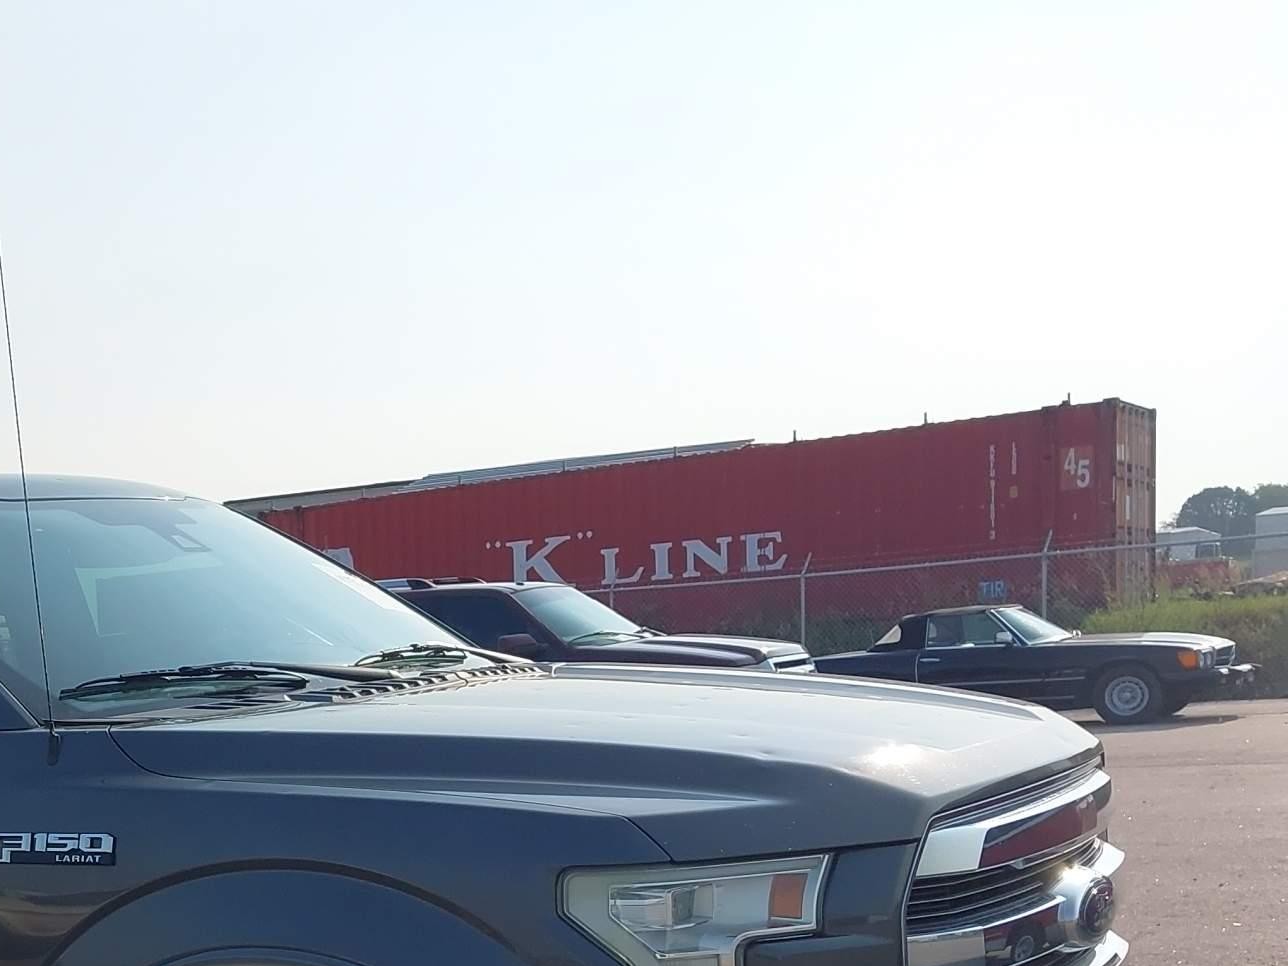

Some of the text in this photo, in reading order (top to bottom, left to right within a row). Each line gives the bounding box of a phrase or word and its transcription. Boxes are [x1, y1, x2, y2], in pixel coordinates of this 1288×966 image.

[1063, 447, 1091, 489] 45
[600, 531, 788, 585] LINE
[55, 854, 102, 863] LARIAT
